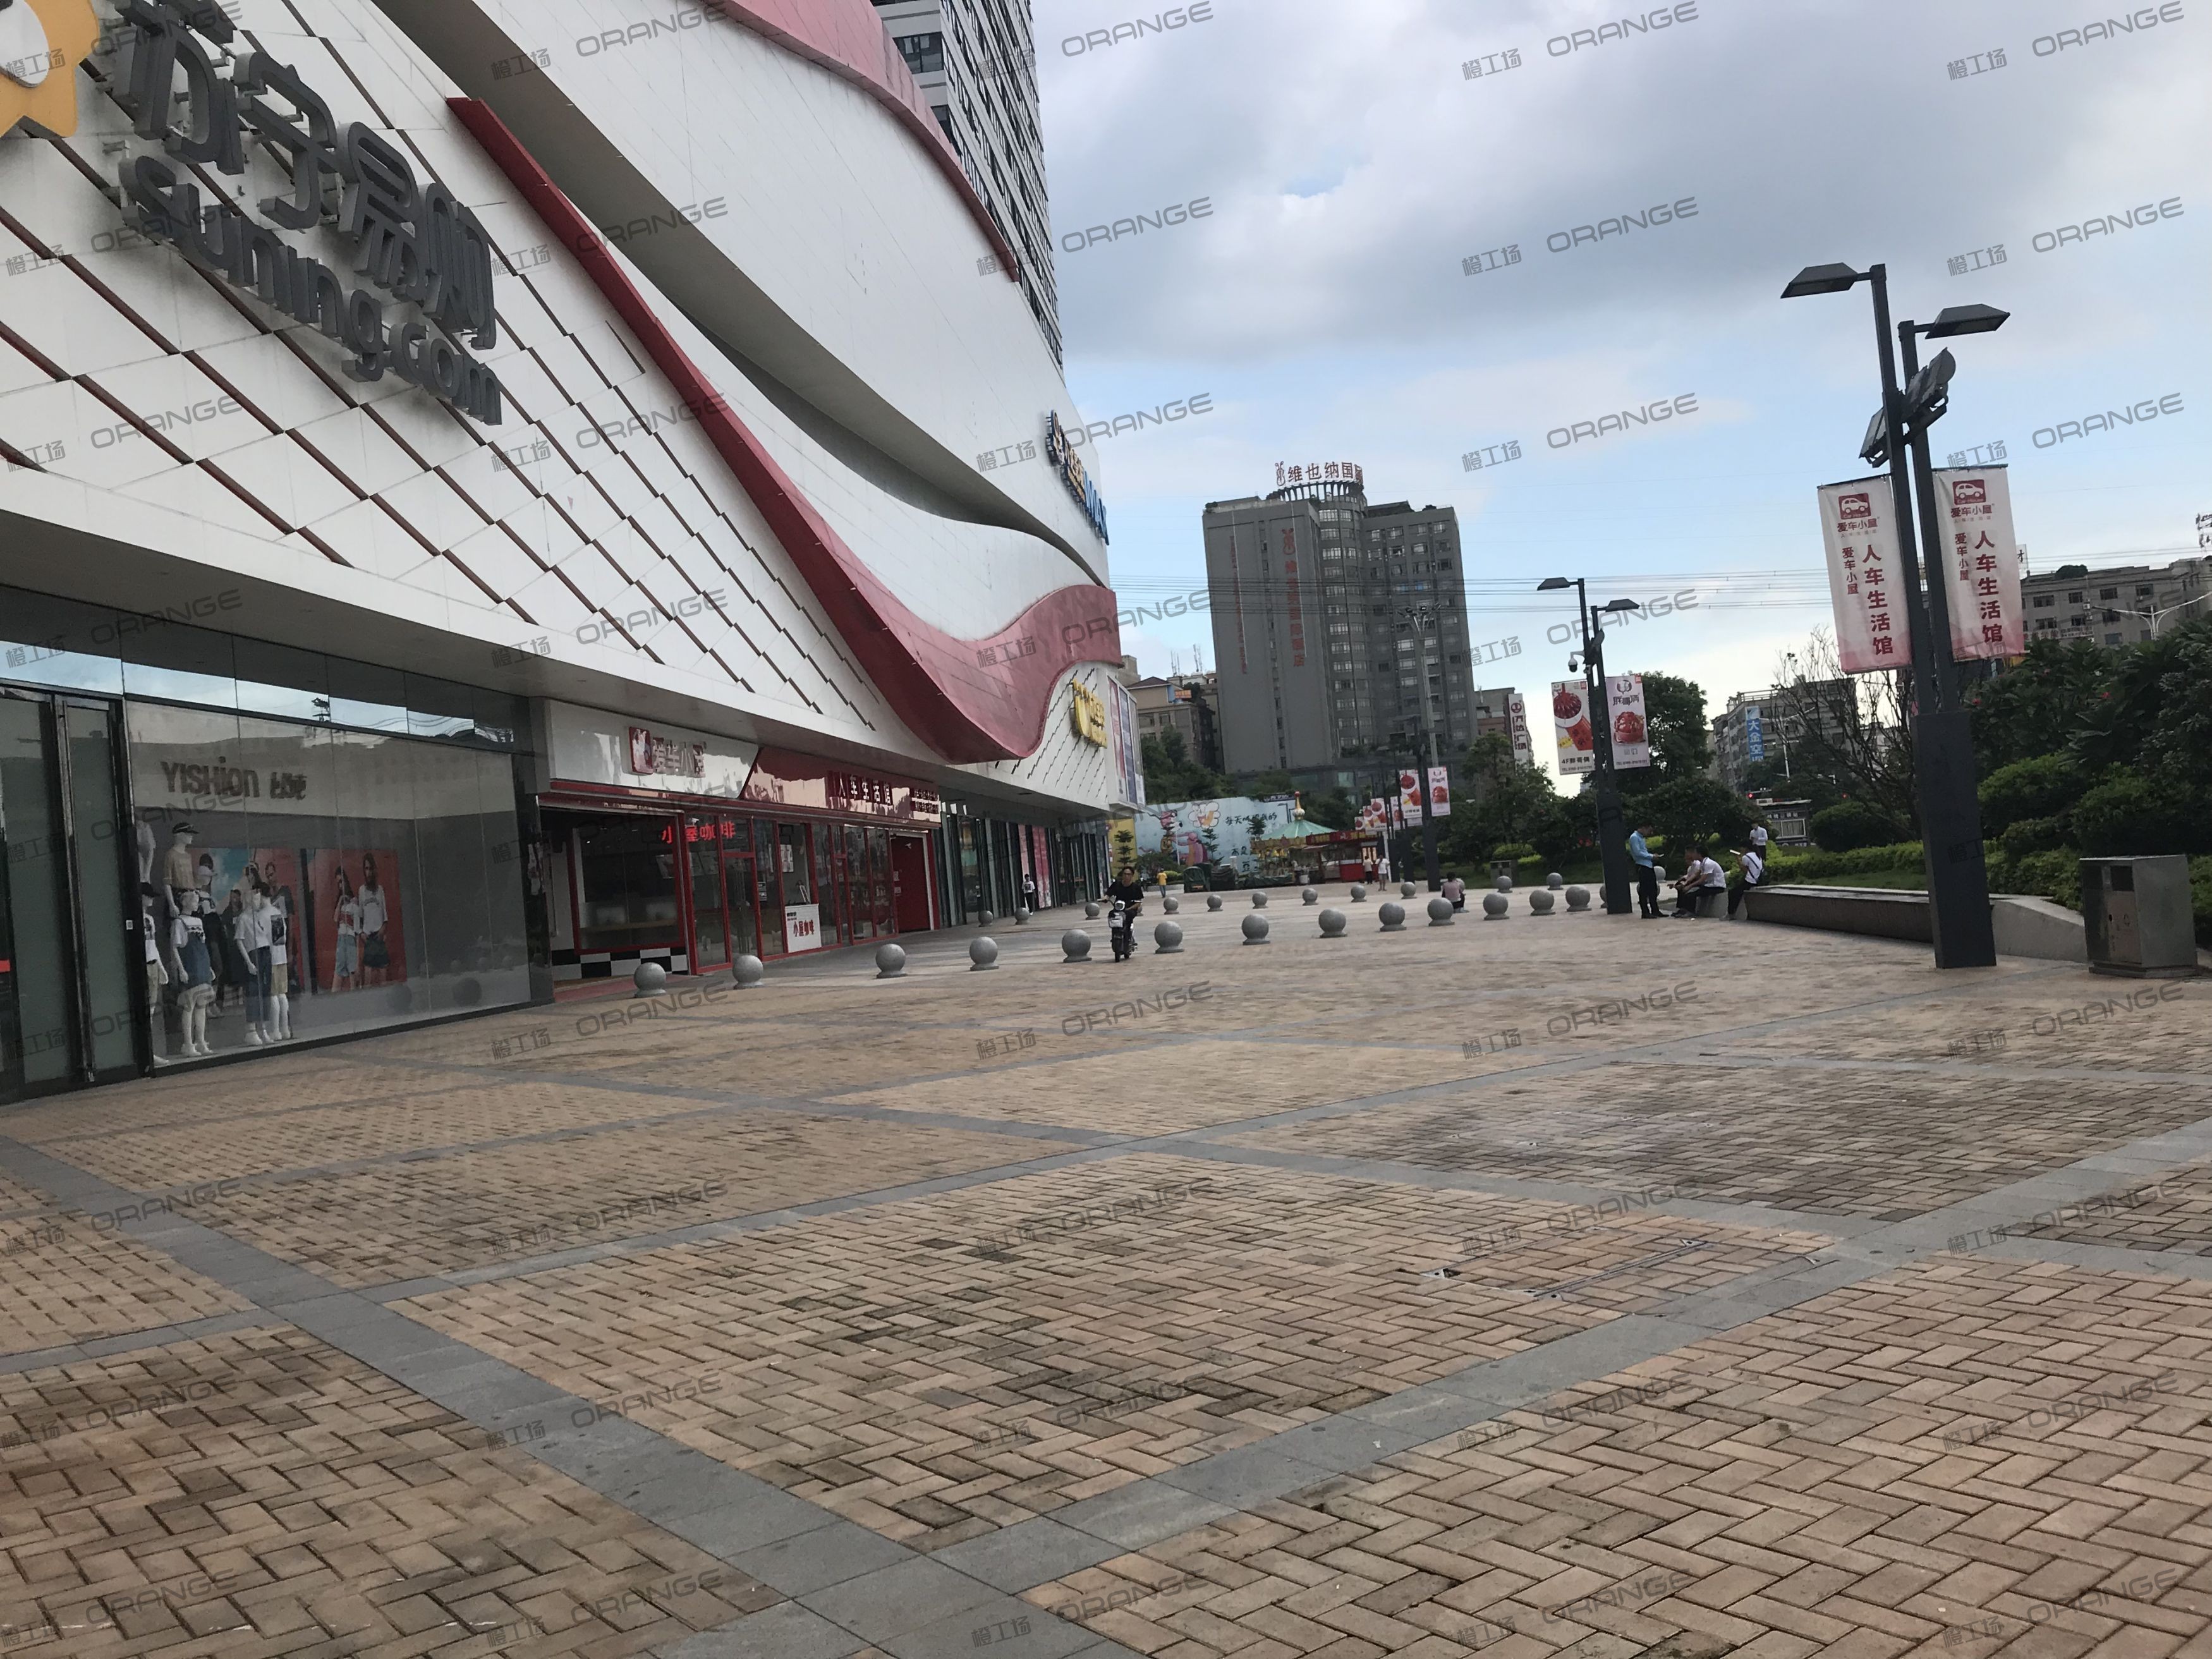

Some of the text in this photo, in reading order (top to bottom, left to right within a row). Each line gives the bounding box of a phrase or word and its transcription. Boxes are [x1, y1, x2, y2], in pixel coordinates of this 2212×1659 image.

[1842, 547, 1859, 595] 爱车小屋
[1955, 532, 1969, 581] 爱车小屋
[1975, 530, 2003, 643] 人车生活馆
[1863, 544, 1893, 656] 人车生活馆
